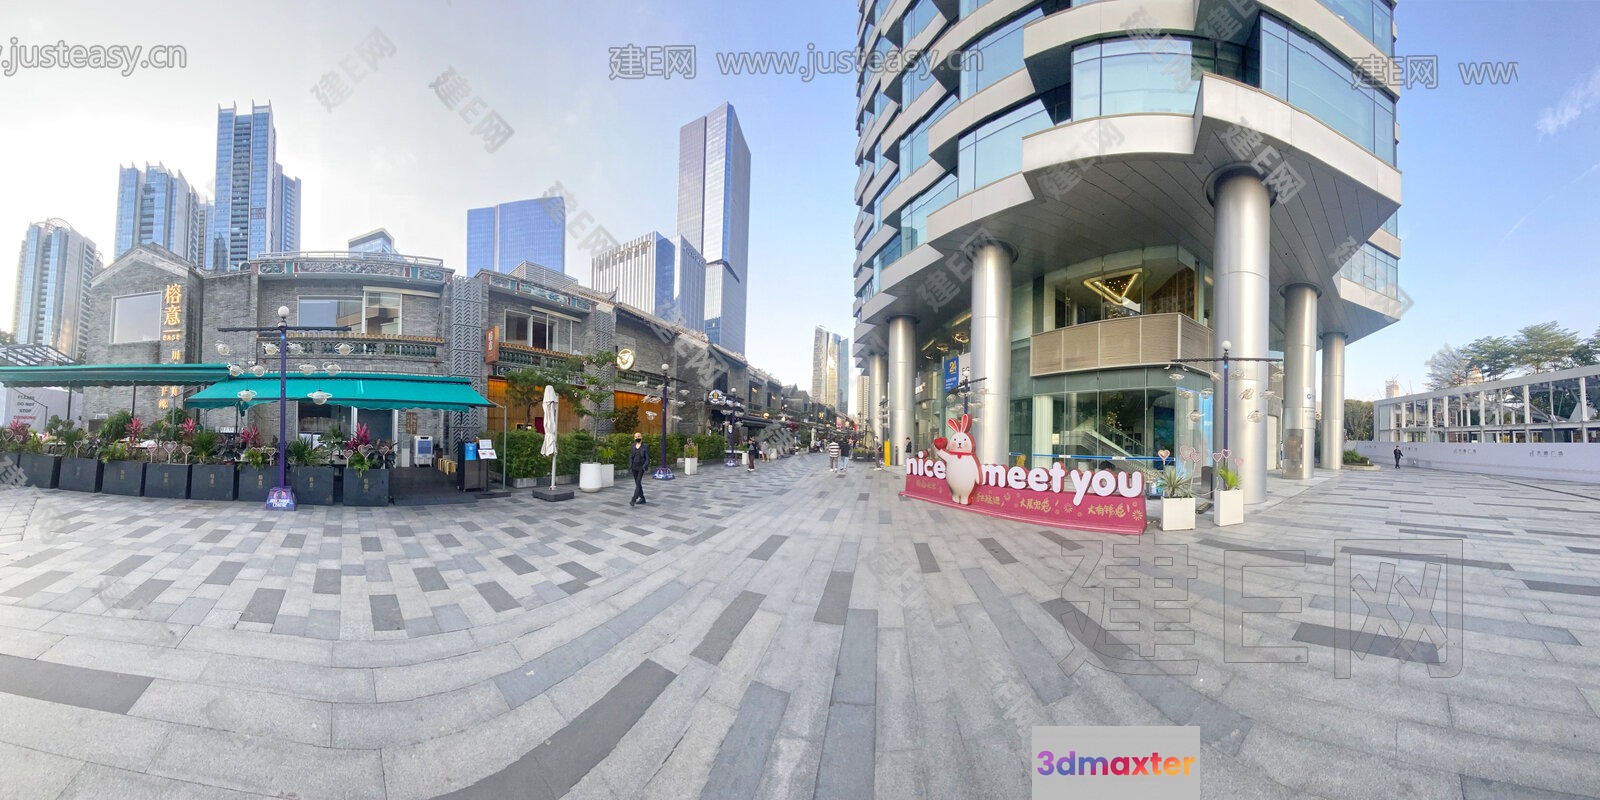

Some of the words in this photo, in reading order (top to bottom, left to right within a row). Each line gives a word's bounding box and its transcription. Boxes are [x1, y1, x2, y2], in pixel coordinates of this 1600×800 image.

[163, 283, 182, 325] 榕意
[906, 451, 946, 479] nice
[981, 461, 1067, 493] meet
[1070, 467, 1144, 506] you
